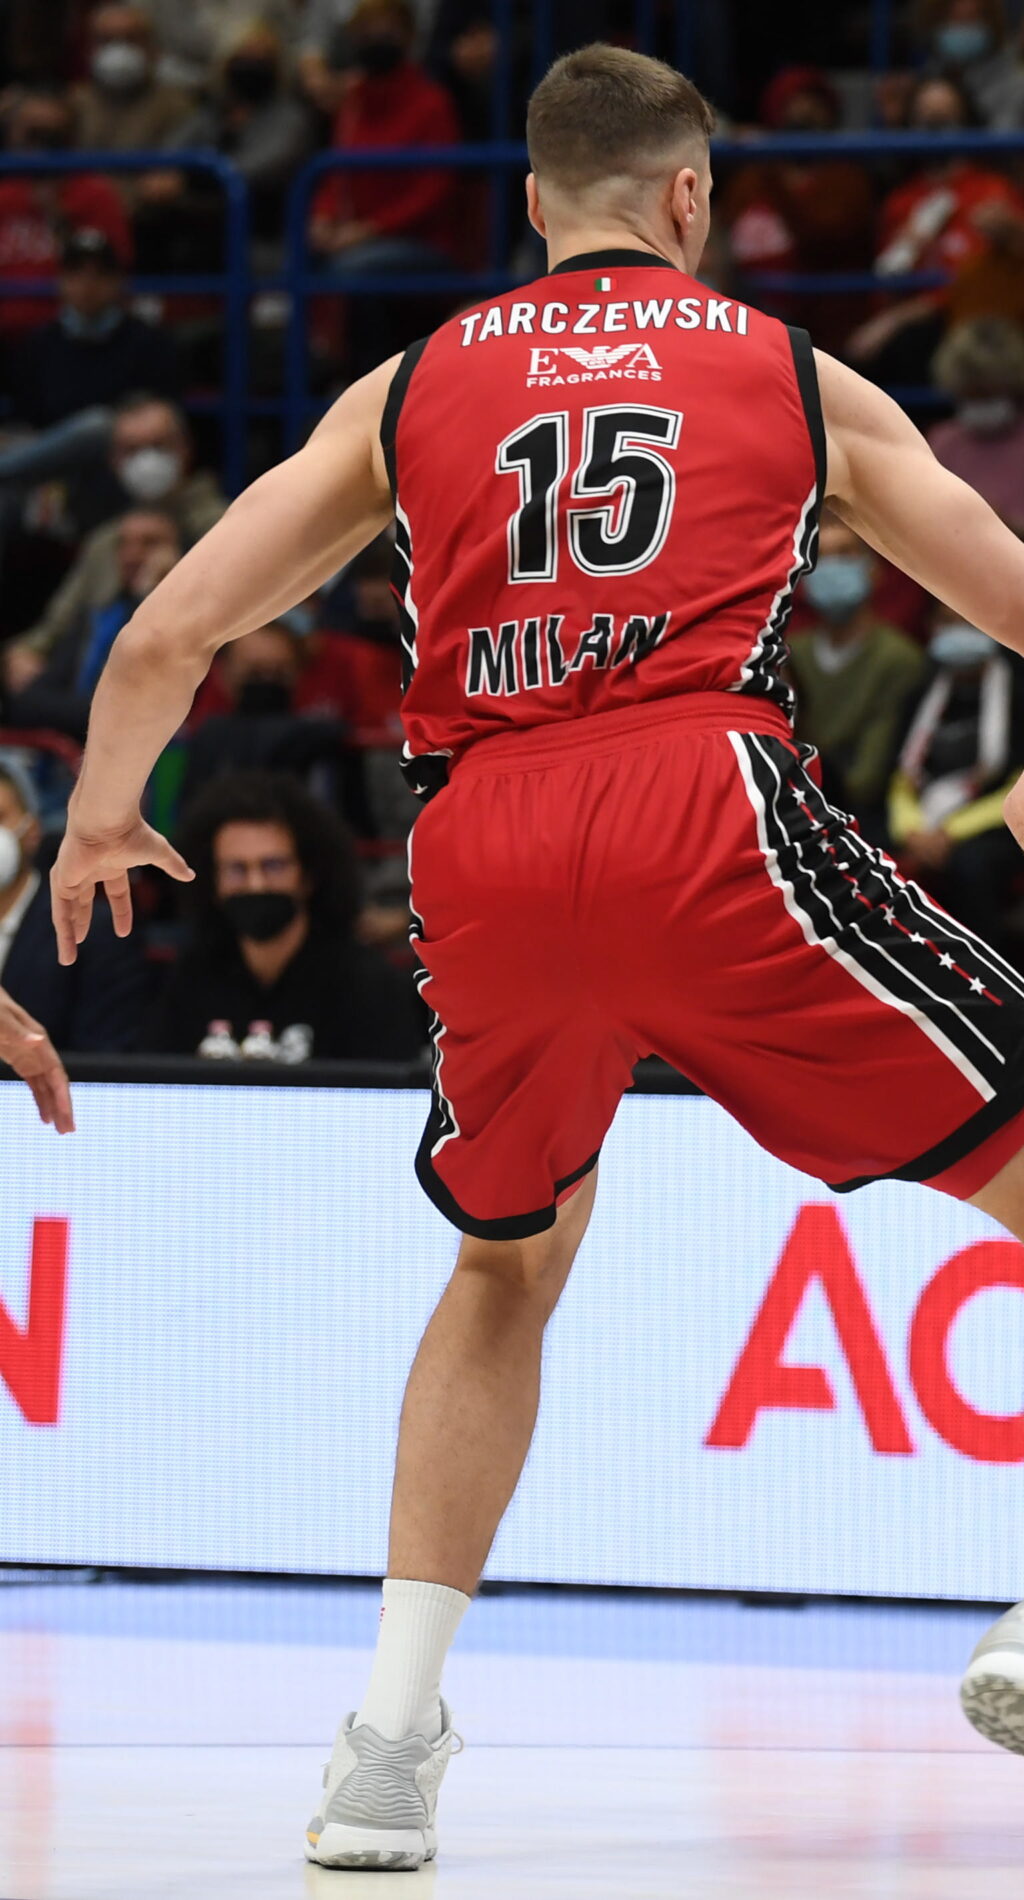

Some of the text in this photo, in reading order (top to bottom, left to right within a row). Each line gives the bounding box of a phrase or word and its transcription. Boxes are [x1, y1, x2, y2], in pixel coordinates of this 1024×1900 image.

[460, 298, 750, 347] TARCZEWSKI
[526, 369, 663, 388] FRAGRANCES
[495, 402, 684, 585] 15
[465, 611, 671, 697] MILAN
